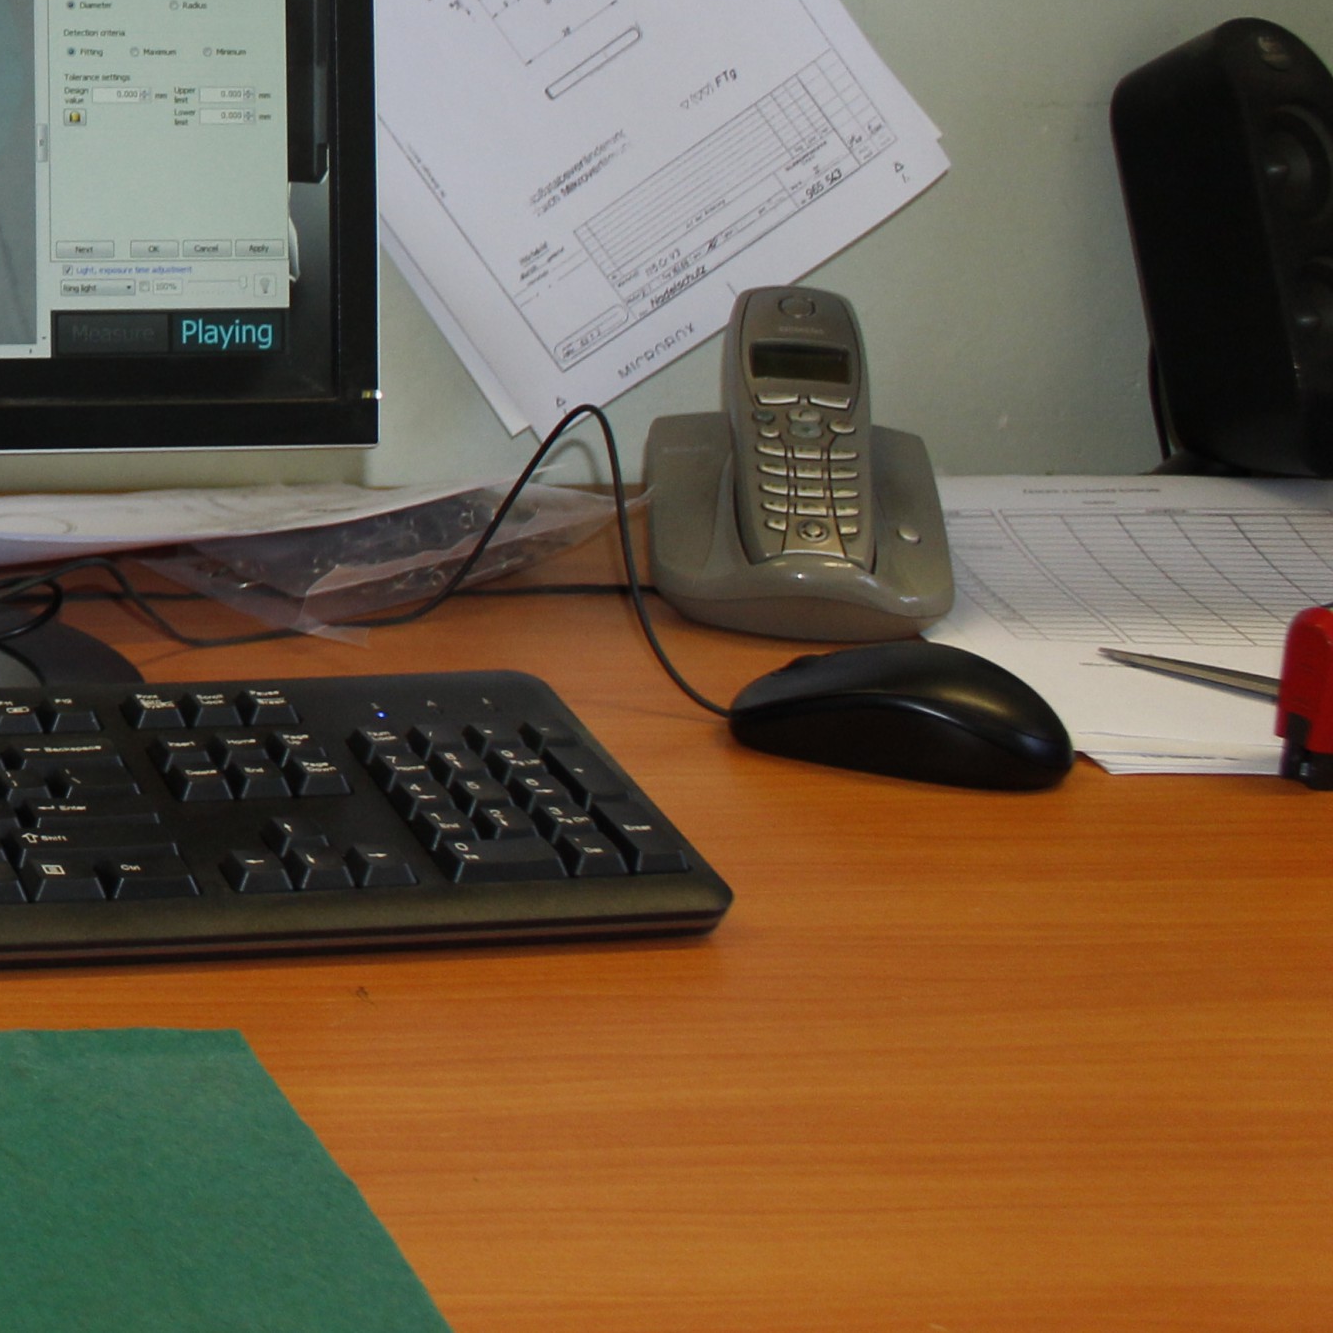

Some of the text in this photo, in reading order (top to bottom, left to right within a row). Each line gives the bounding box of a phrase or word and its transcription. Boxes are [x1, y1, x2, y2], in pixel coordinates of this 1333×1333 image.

[79, 1, 112, 10] Diameter
[182, 1, 207, 10] Radius
[63, 28, 126, 37] Detection criteria
[79, 48, 104, 58] Fitting
[142, 48, 177, 57] Maximum
[216, 48, 247, 57] Minimum
[64, 73, 131, 84] Tolerance settings
[64, 86, 89, 97] Design
[174, 86, 196, 97] Upper
[64, 97, 85, 105] value
[174, 108, 196, 117] Lower
[148, 245, 160, 253] OK
[193, 243, 219, 253] Cancel
[248, 243, 269, 255] Apply
[79, 283, 97, 294] light
[71, 323, 155, 340] Measure
[181, 319, 274, 350] Playing
